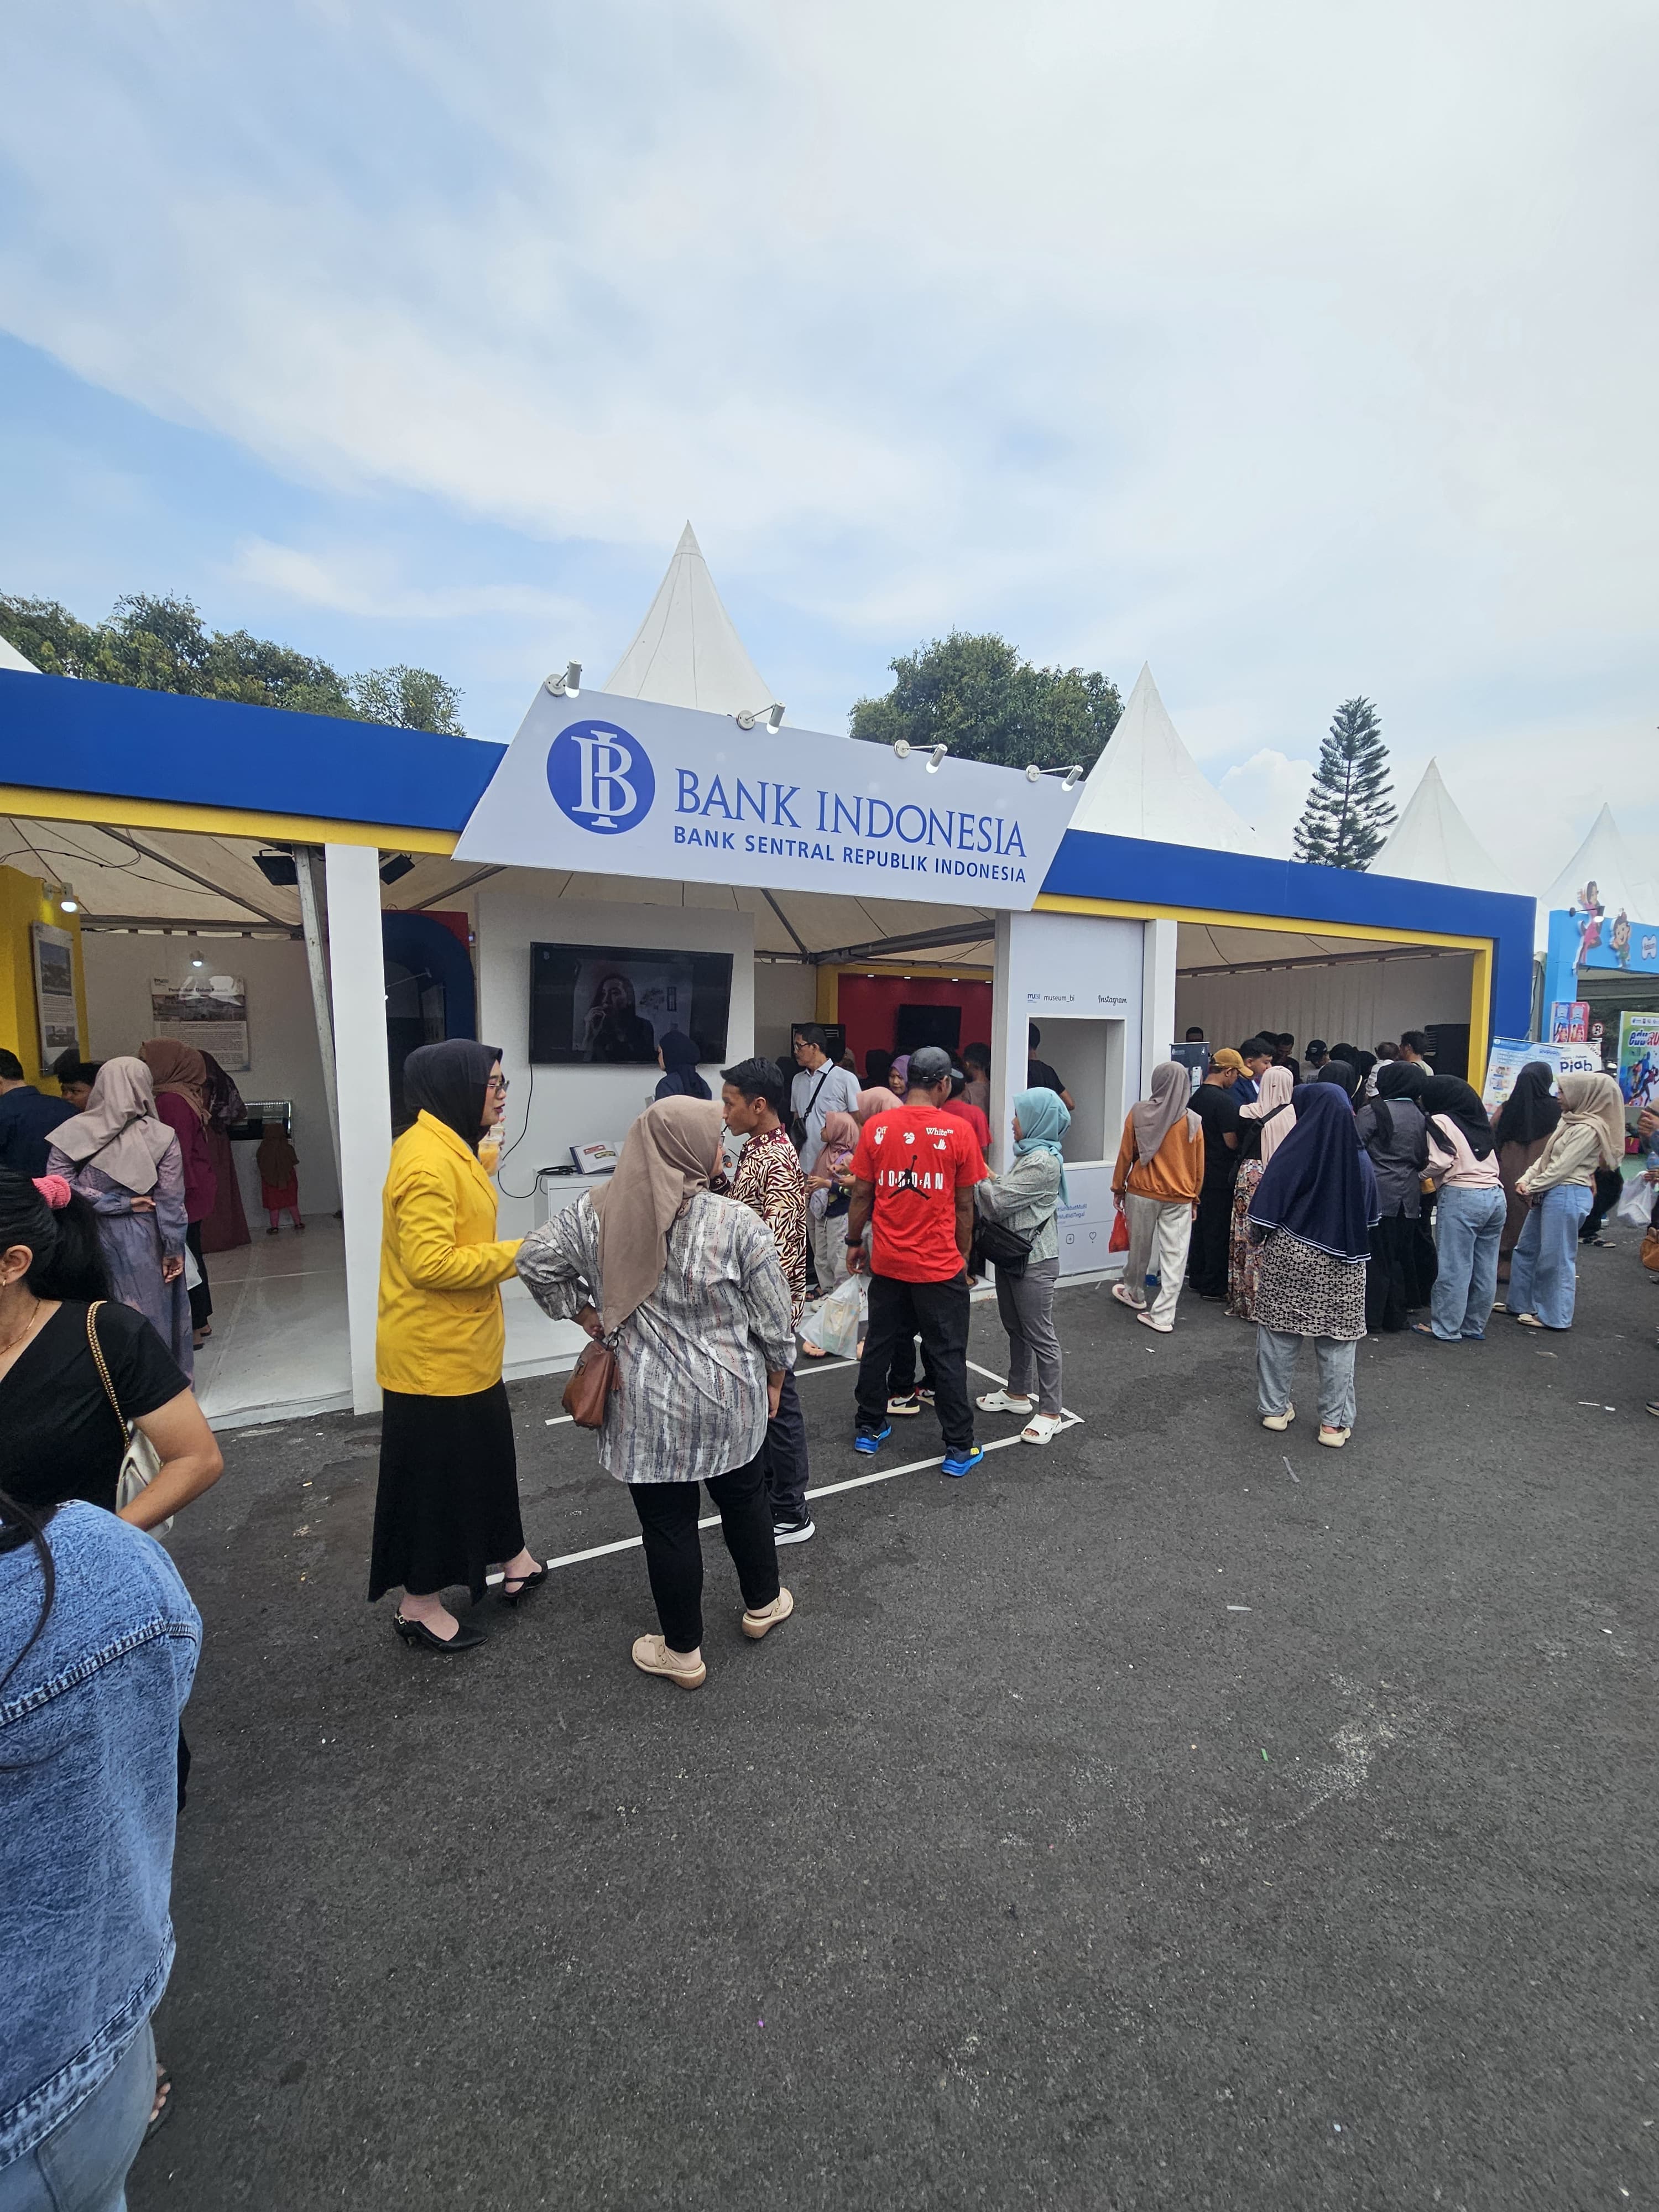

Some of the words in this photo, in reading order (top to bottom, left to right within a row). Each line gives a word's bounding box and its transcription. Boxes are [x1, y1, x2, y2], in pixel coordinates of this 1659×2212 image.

[675, 768, 801, 829] BANK
[816, 790, 1026, 858] INDONESIA
[674, 825, 735, 850] BANK
[745, 834, 834, 862] SENTRAL
[843, 847, 927, 872] REPUBLIK
[935, 859, 1026, 883] INDONESIA
[1044, 994, 1075, 1003] museum_bi
[1098, 995, 1128, 1006] Instagram
